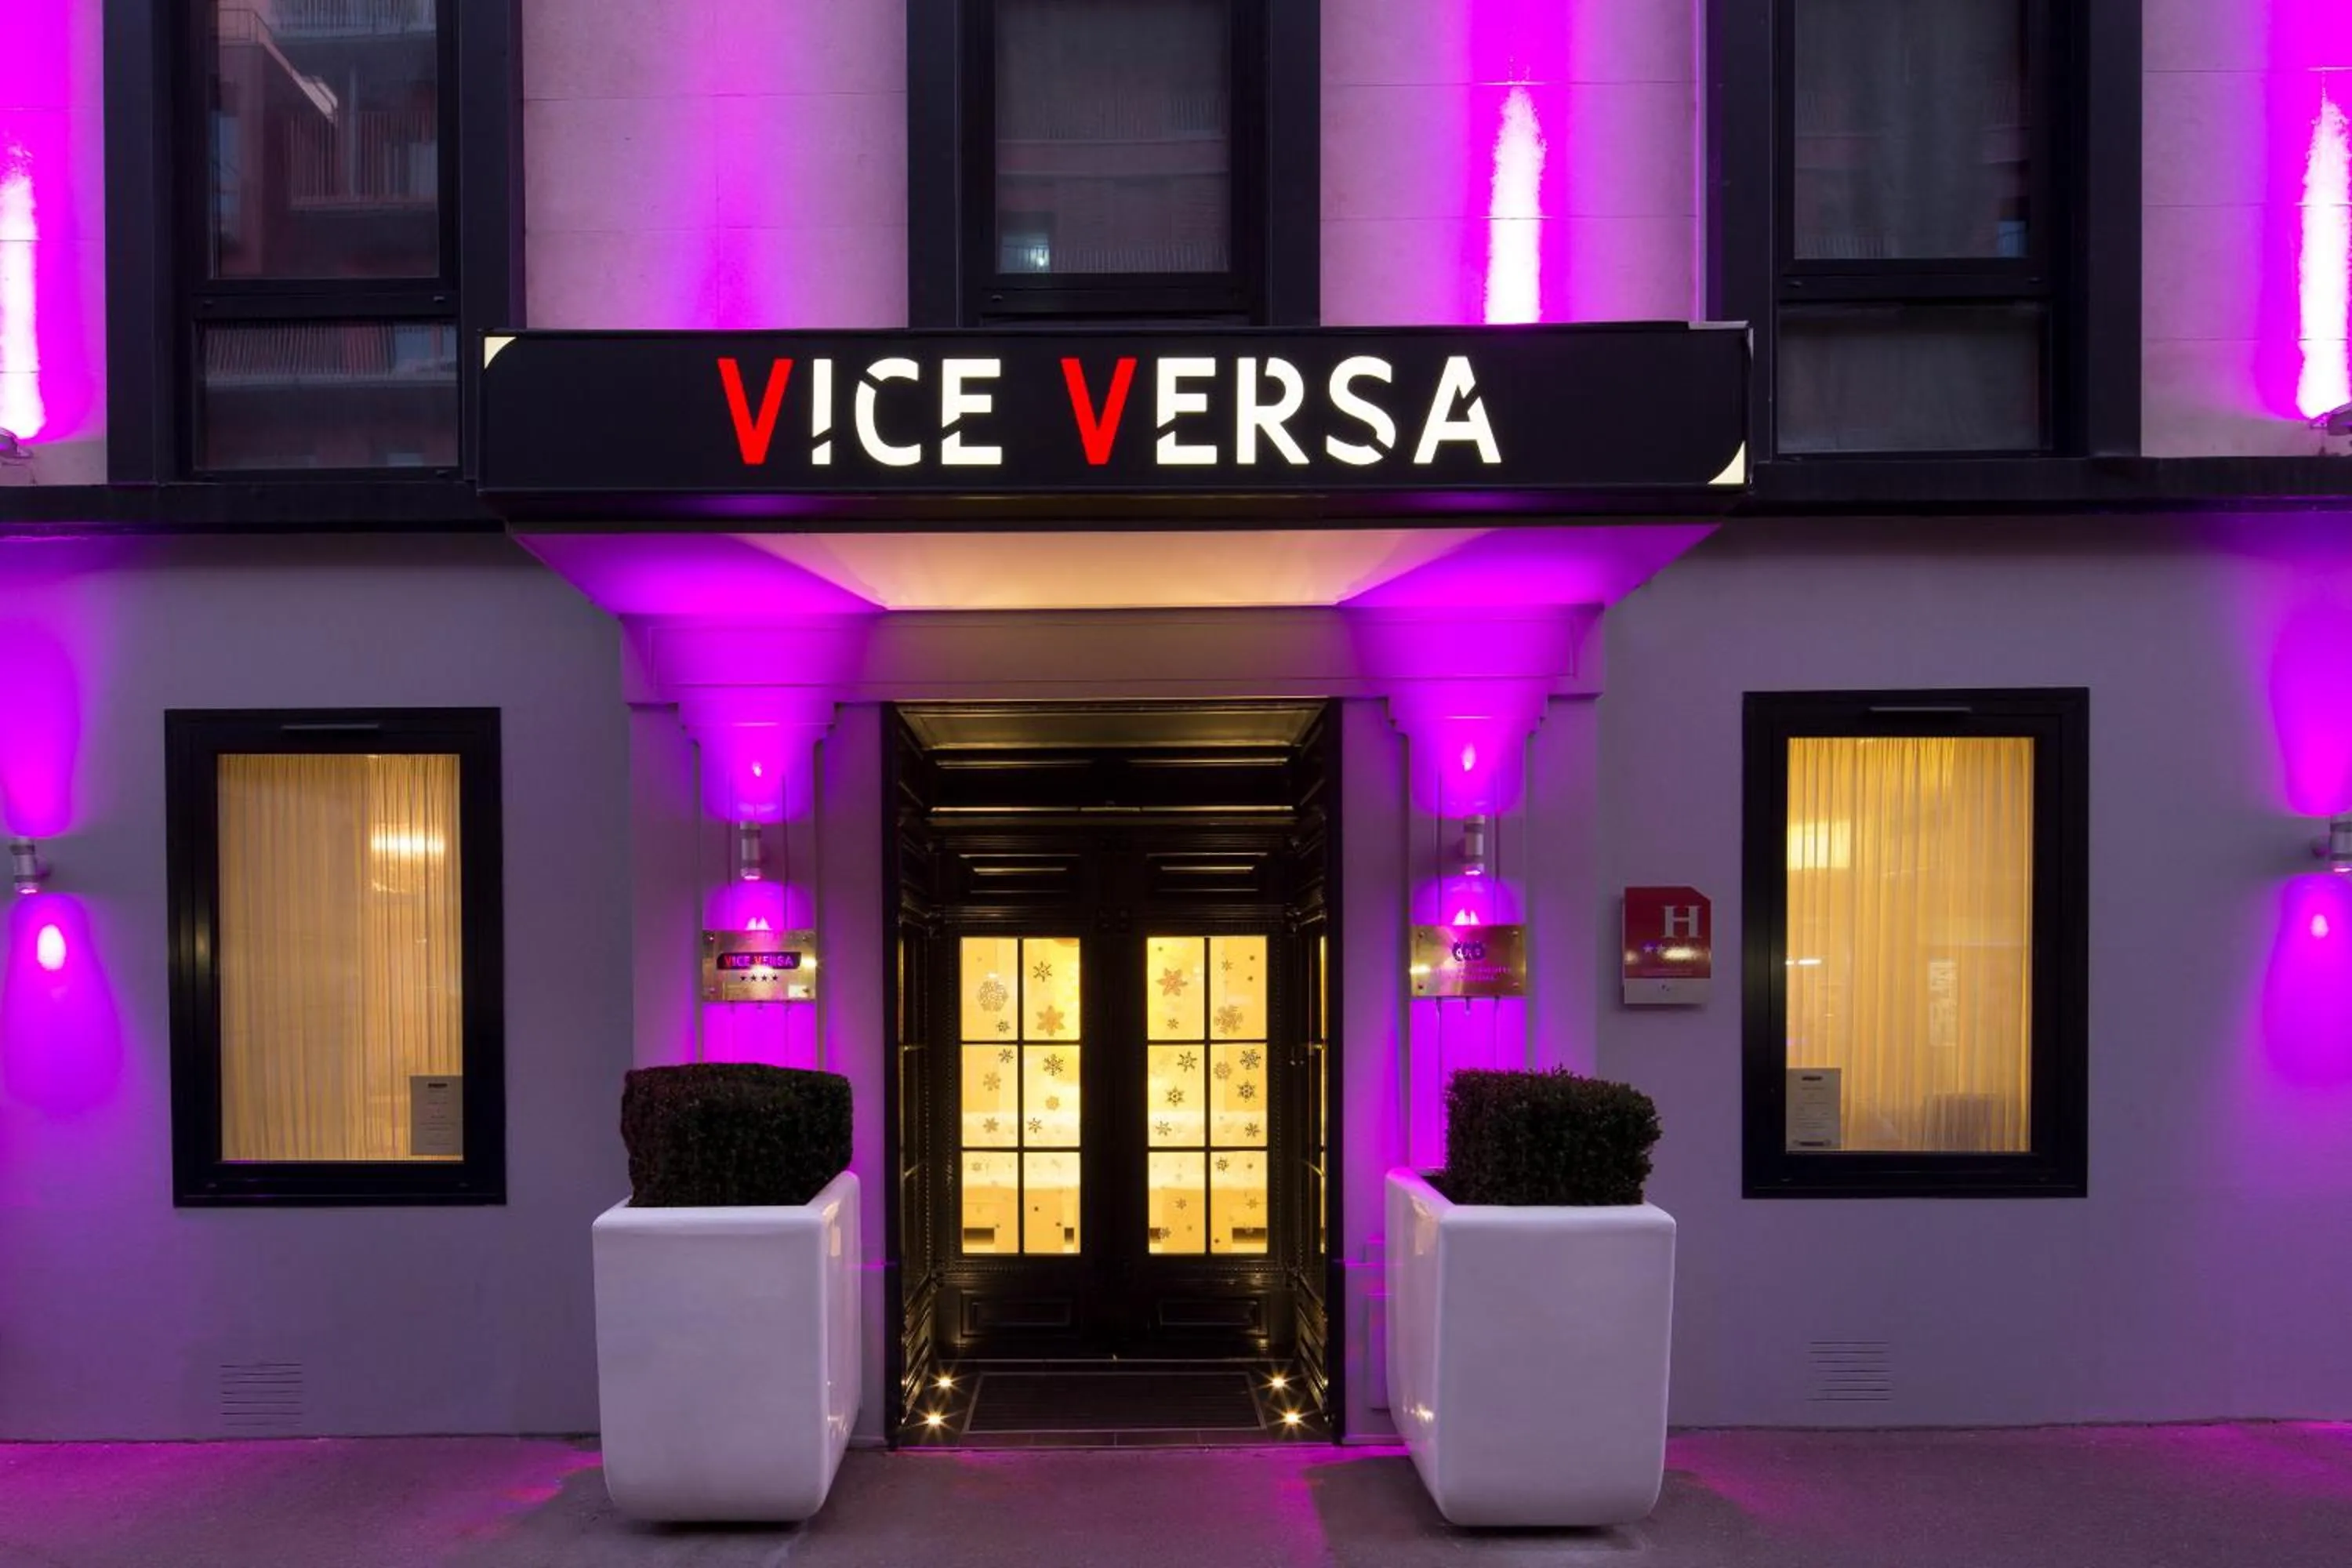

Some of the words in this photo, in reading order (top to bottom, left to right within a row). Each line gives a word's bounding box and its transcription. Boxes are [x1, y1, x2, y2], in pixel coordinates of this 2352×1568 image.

[717, 357, 1003, 466] VICE
[1060, 355, 1502, 465] VERSA
[1663, 905, 1702, 938] H
[724, 955, 750, 967] VICE
[753, 955, 794, 967] VERSA
